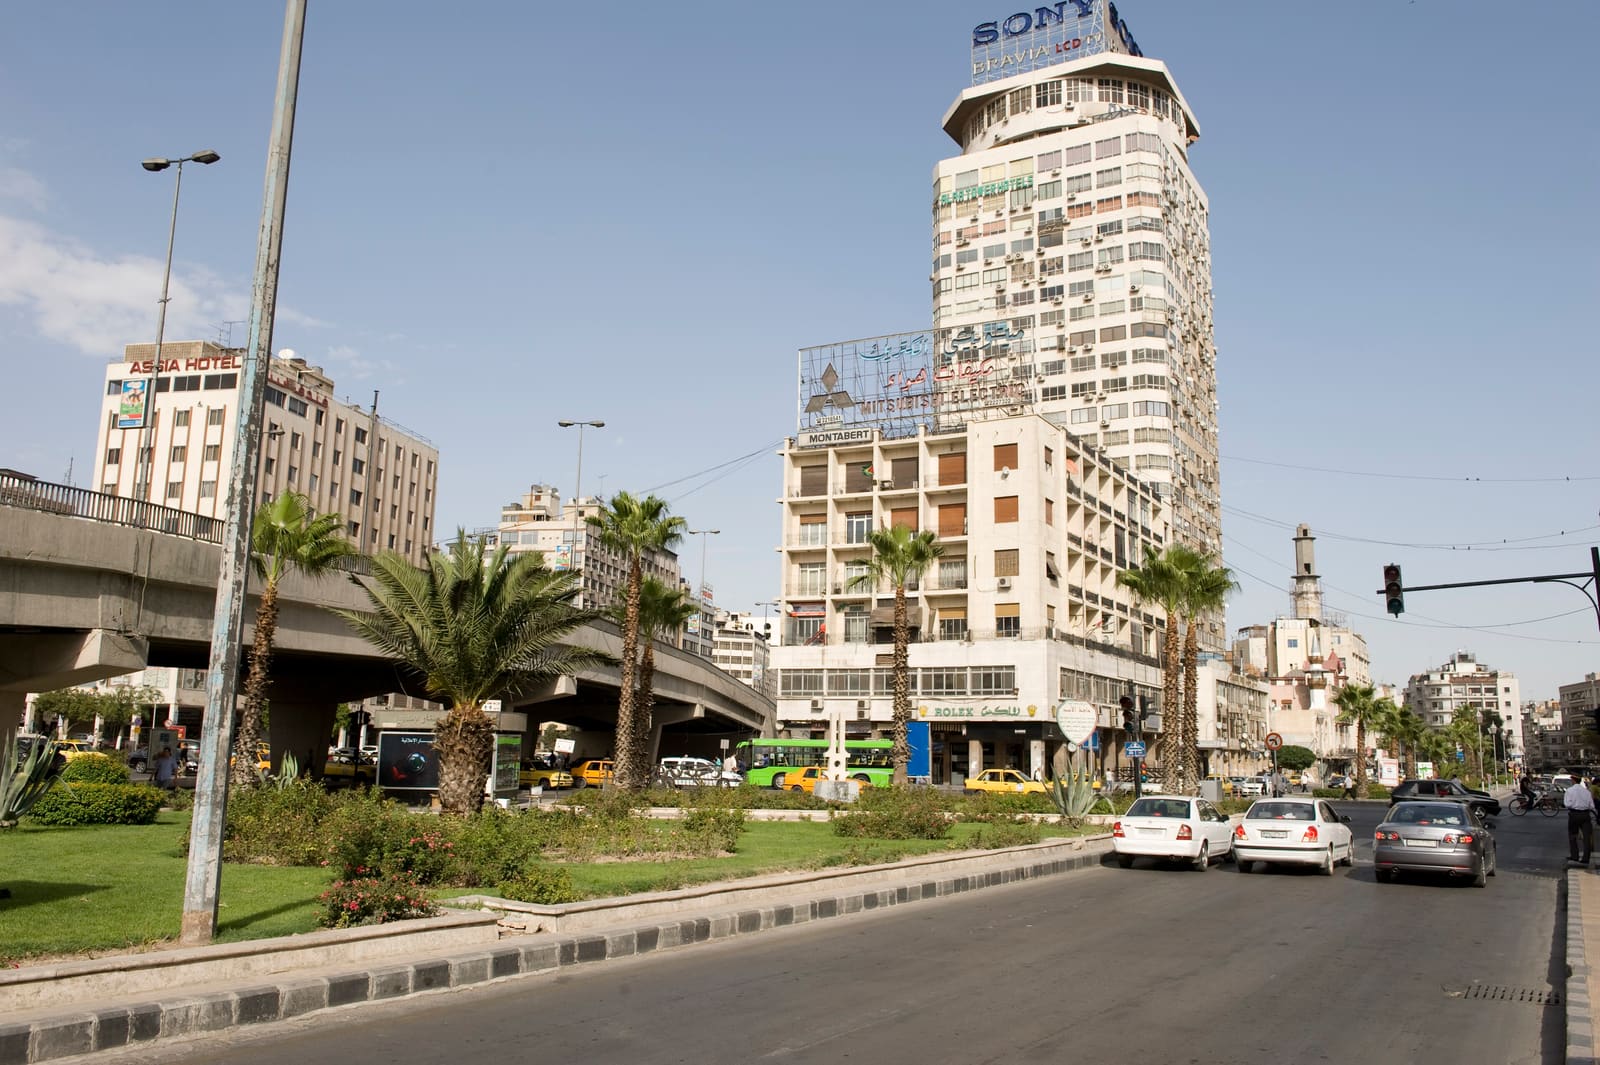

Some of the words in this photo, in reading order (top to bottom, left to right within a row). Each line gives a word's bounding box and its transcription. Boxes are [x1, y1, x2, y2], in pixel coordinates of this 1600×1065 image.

[973, 0, 1093, 48] SONY
[973, 45, 1050, 76] BRAVIA
[1055, 38, 1082, 54] LCD
[130, 358, 180, 374] ASSIA
[185, 356, 242, 371] HOTEL
[809, 430, 869, 443] MONTABERT
[935, 707, 974, 717] ROLEX
